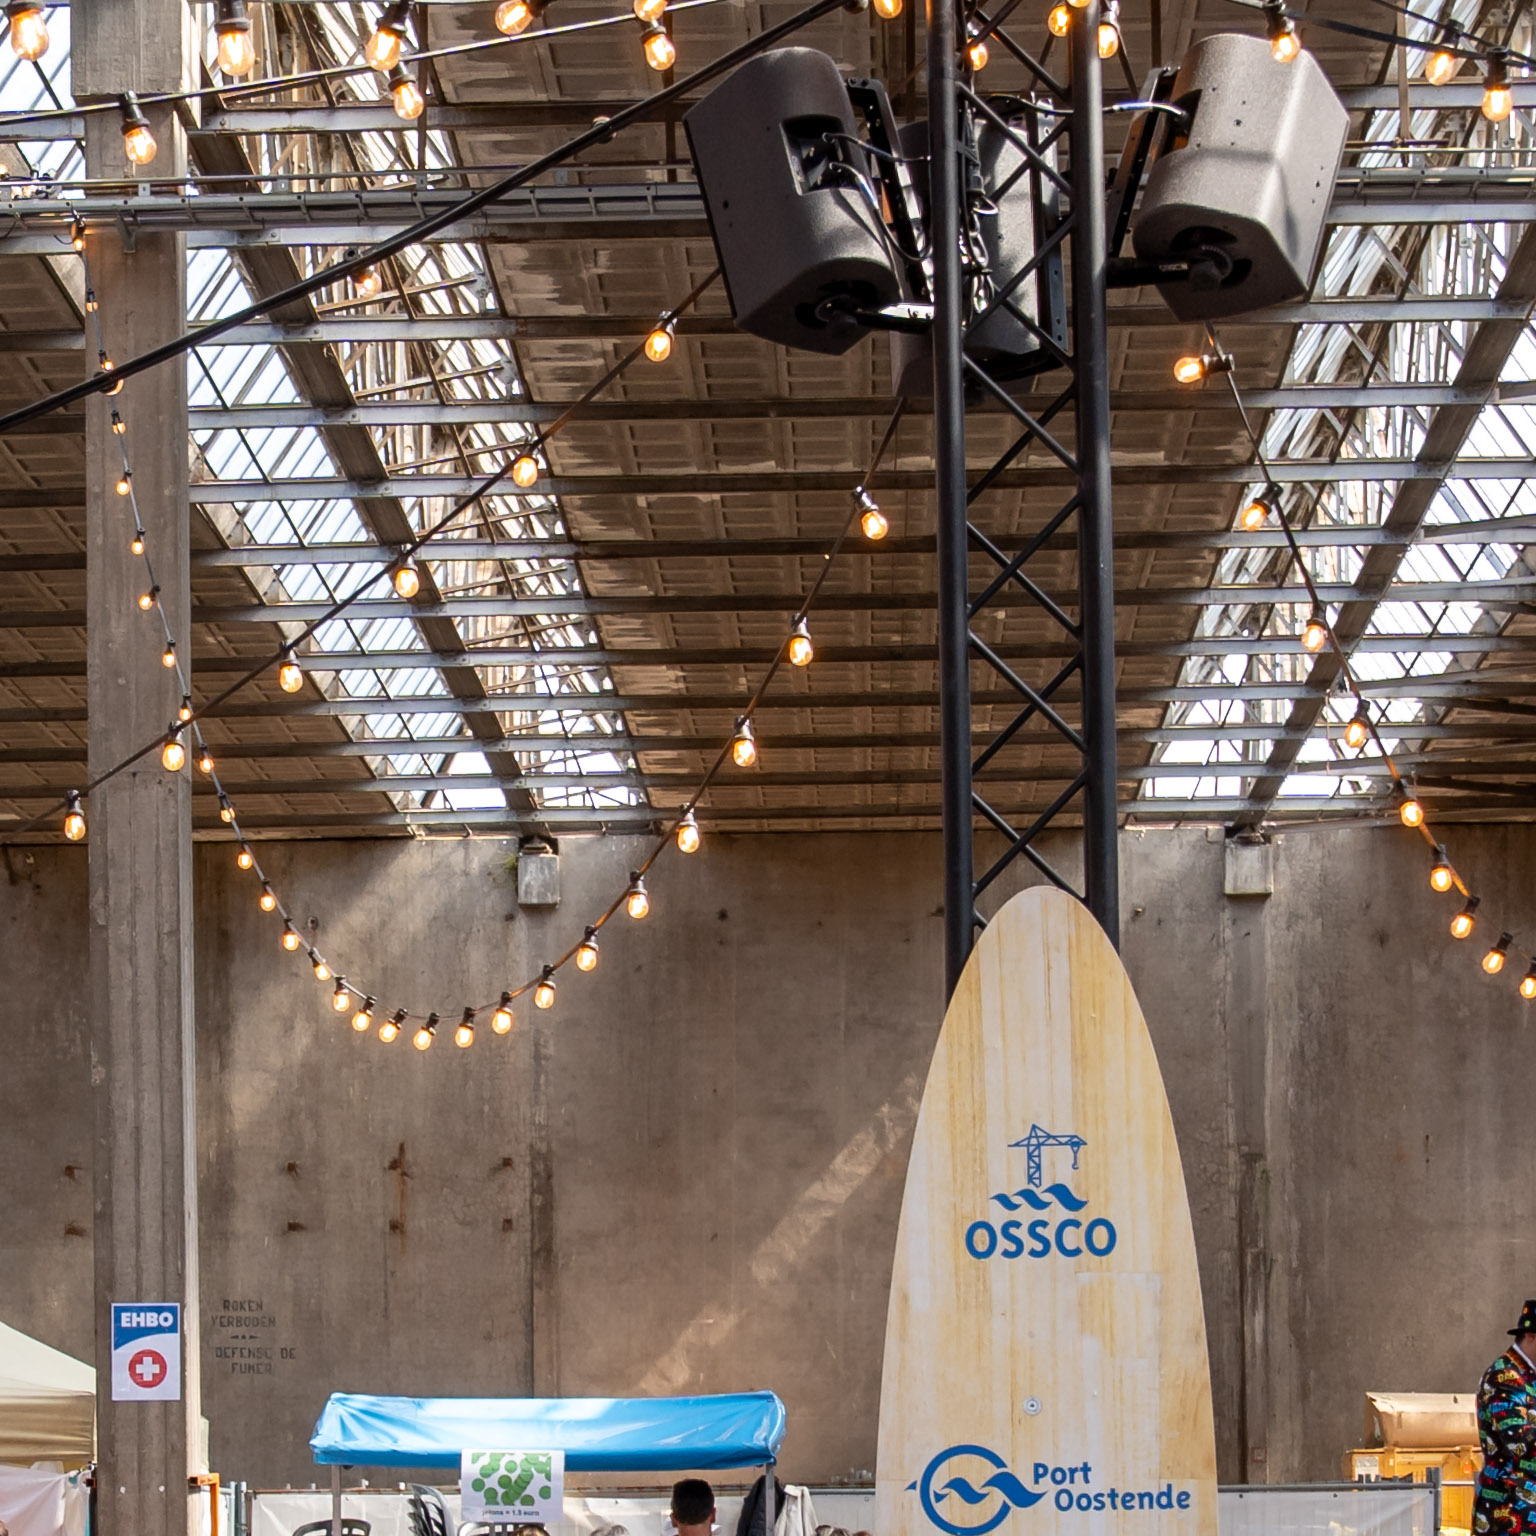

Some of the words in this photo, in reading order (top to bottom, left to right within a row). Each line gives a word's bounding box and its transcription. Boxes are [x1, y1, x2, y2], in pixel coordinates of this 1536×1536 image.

[965, 1217, 1117, 1260] OSSCO
[223, 1300, 263, 1312] ROKEN
[120, 1311, 174, 1328] EHBO
[211, 1315, 276, 1328] VERBODEN
[215, 1347, 272, 1360] DEFENSE
[280, 1347, 296, 1360] DE
[221, 1362, 272, 1375] FUMER
[1033, 1461, 1092, 1485] Port
[1054, 1483, 1191, 1512] Oostende
